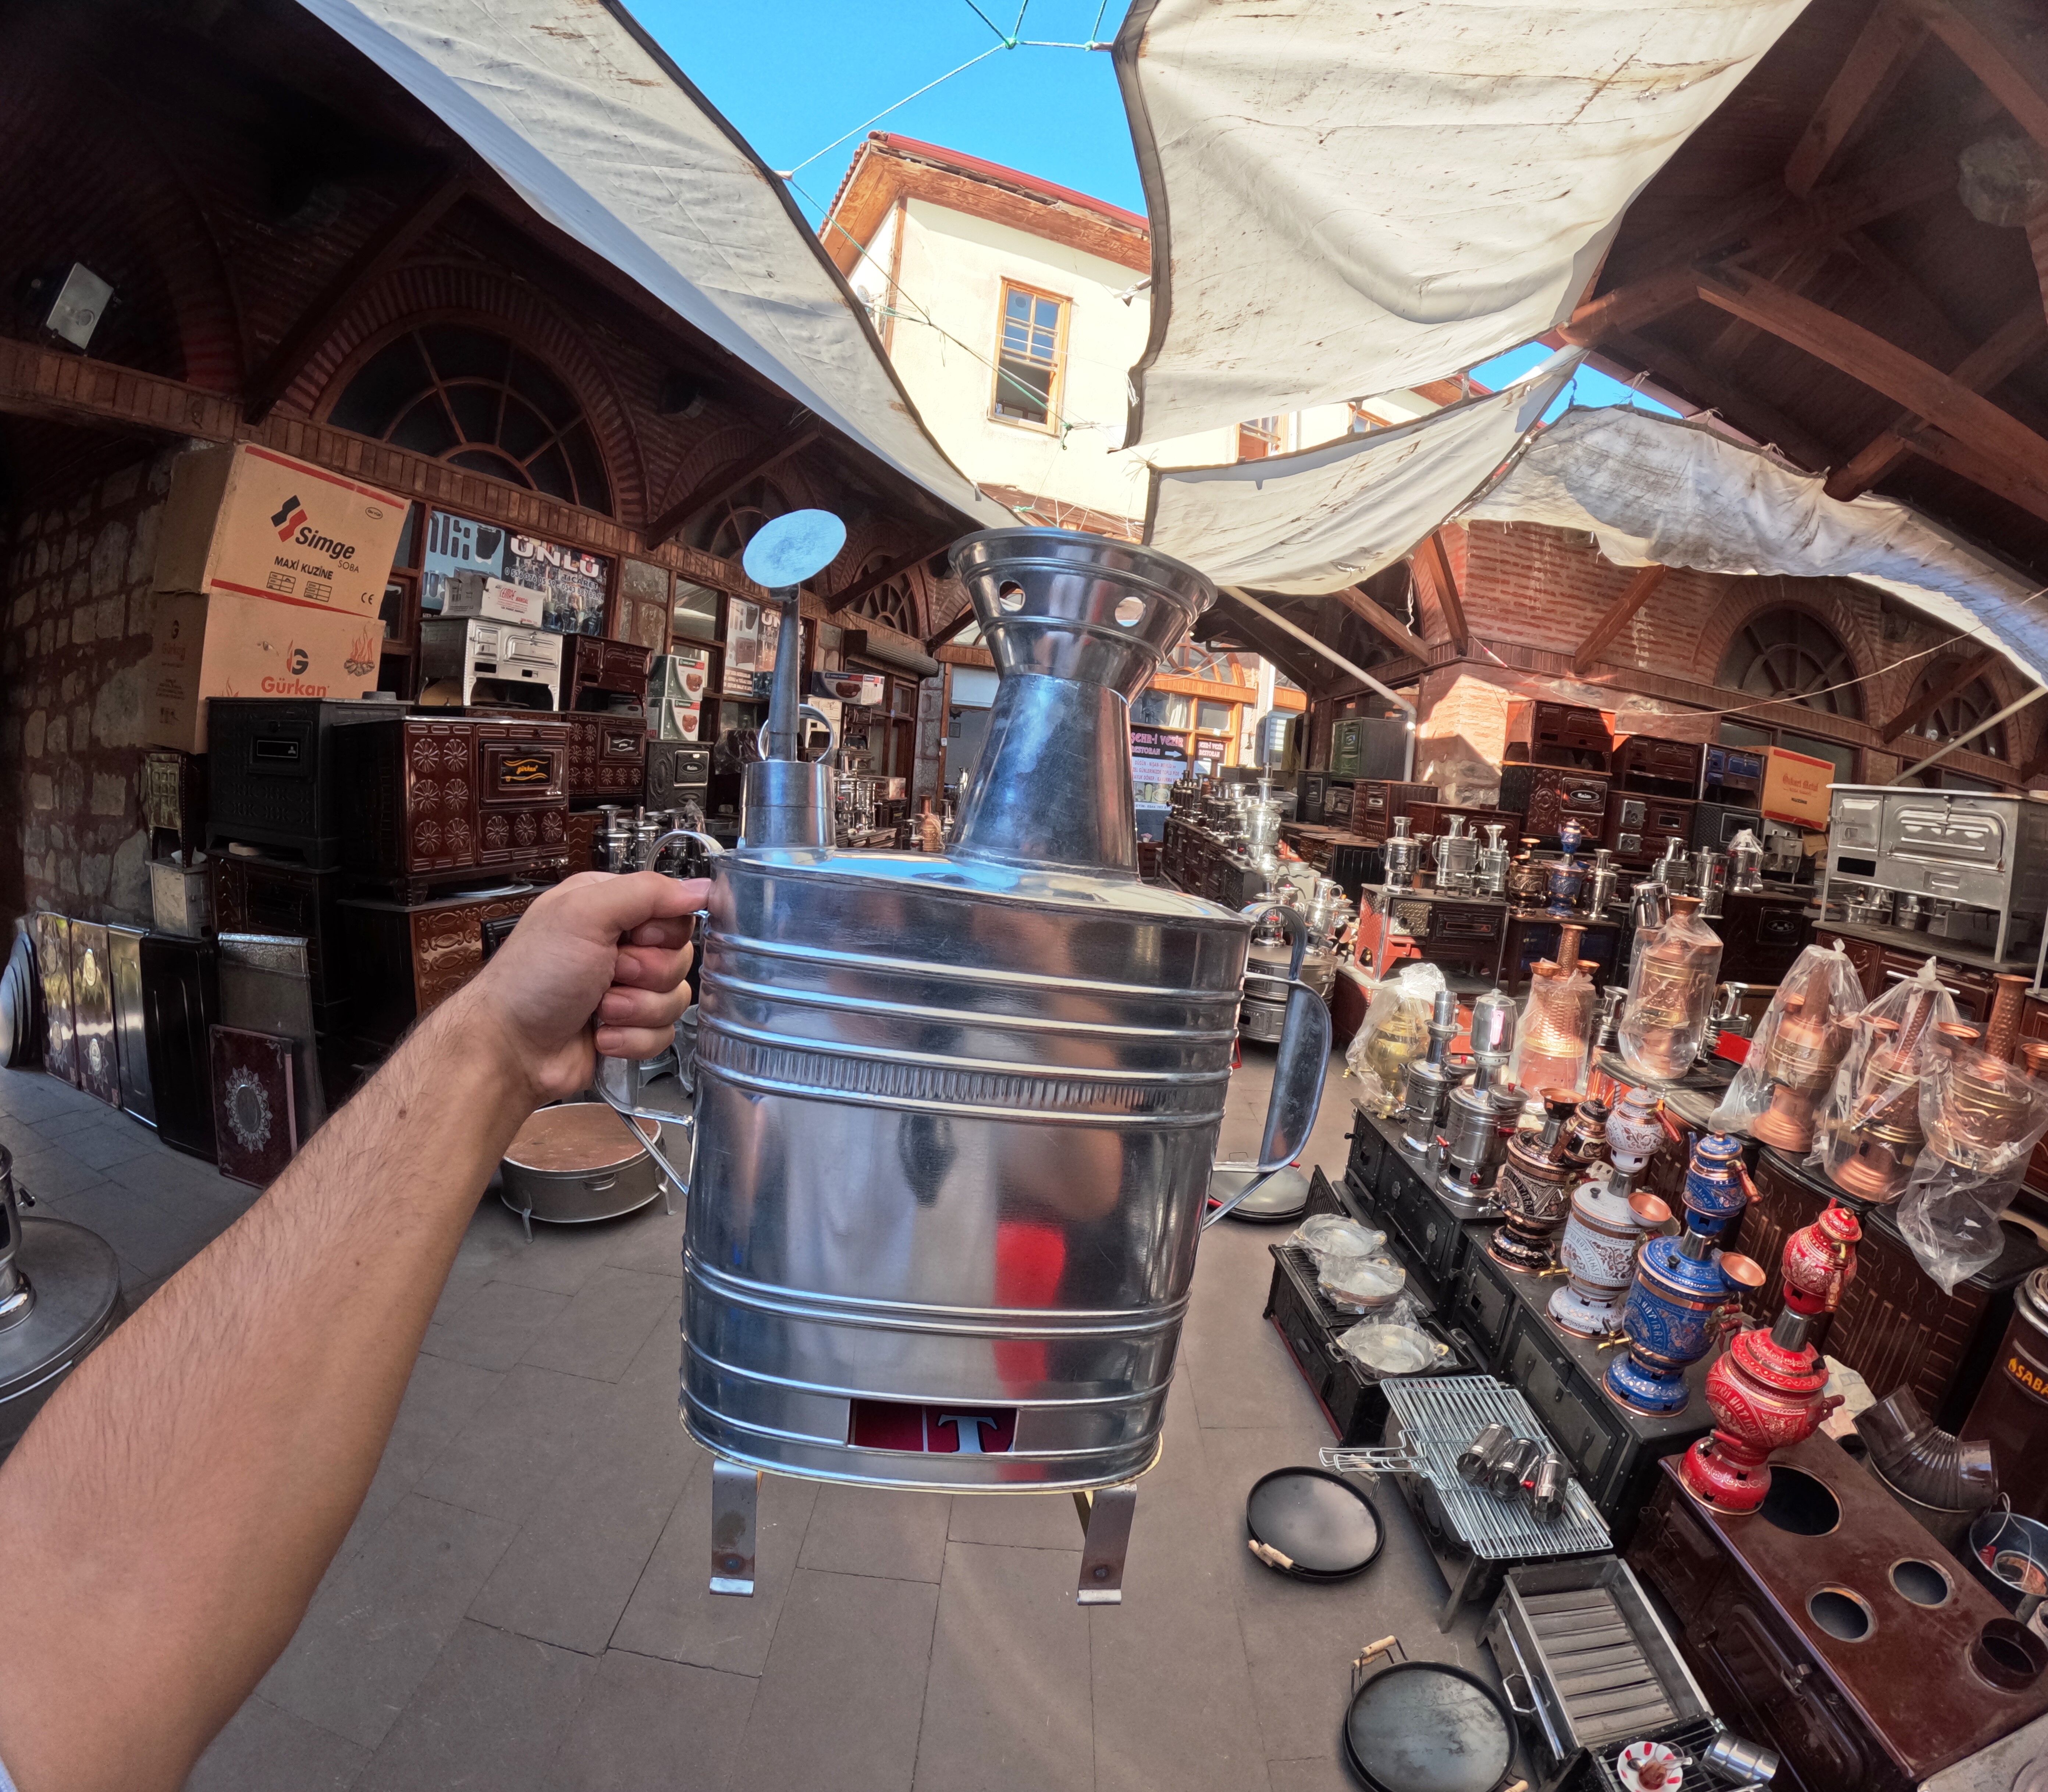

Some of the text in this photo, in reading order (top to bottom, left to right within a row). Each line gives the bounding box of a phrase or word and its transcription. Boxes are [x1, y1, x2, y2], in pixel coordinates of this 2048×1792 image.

[295, 526, 355, 559] Simge
[274, 555, 334, 580] MAXİ KUZİNE
[338, 560, 359, 573] SOBA
[511, 535, 599, 578] ÜNLÜ
[511, 568, 523, 579] 536
[524, 573, 537, 583] 376
[548, 579, 556, 587] 59
[561, 583, 576, 593] 0543
[361, 592, 375, 605] CE
[261, 676, 327, 697] Gürkan
[1160, 735, 1184, 748] VEZİR
[1198, 749, 1220, 758] RESTORAN
[938, 1414, 998, 1454] T
